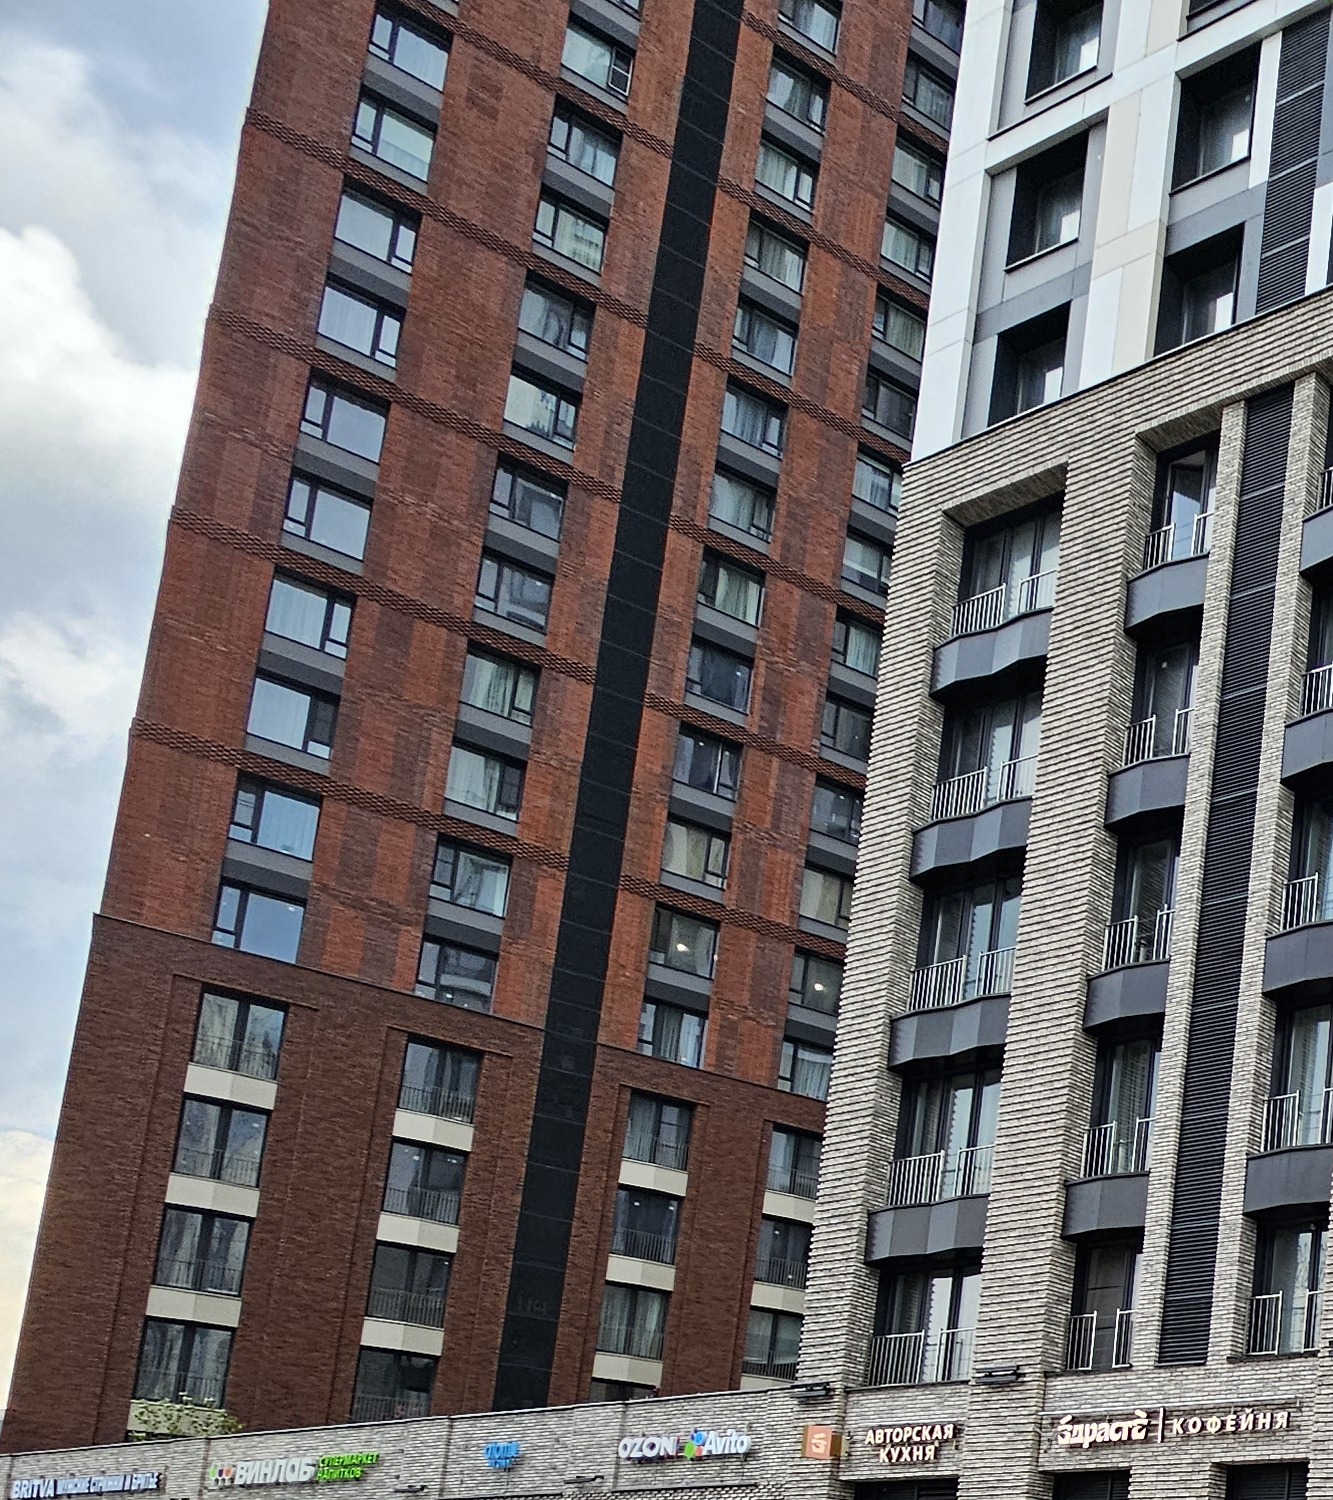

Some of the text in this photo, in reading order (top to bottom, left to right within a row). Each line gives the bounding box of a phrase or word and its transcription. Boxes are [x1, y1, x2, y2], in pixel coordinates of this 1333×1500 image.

[1171, 1408, 1290, 1435] КОФЕЙНЯ
[703, 1429, 750, 1456] Avito
[864, 1423, 955, 1445] АВТОРСКАЯ
[618, 1436, 679, 1458] OZON
[879, 1444, 935, 1463] КУХНЯ
[319, 1452, 379, 1466] СУПЕРМАРКЕТ
[234, 1458, 315, 1484] ВИНЛАБ
[317, 1467, 364, 1482] НАПИТКОВ
[11, 1479, 55, 1499] BRITVA
